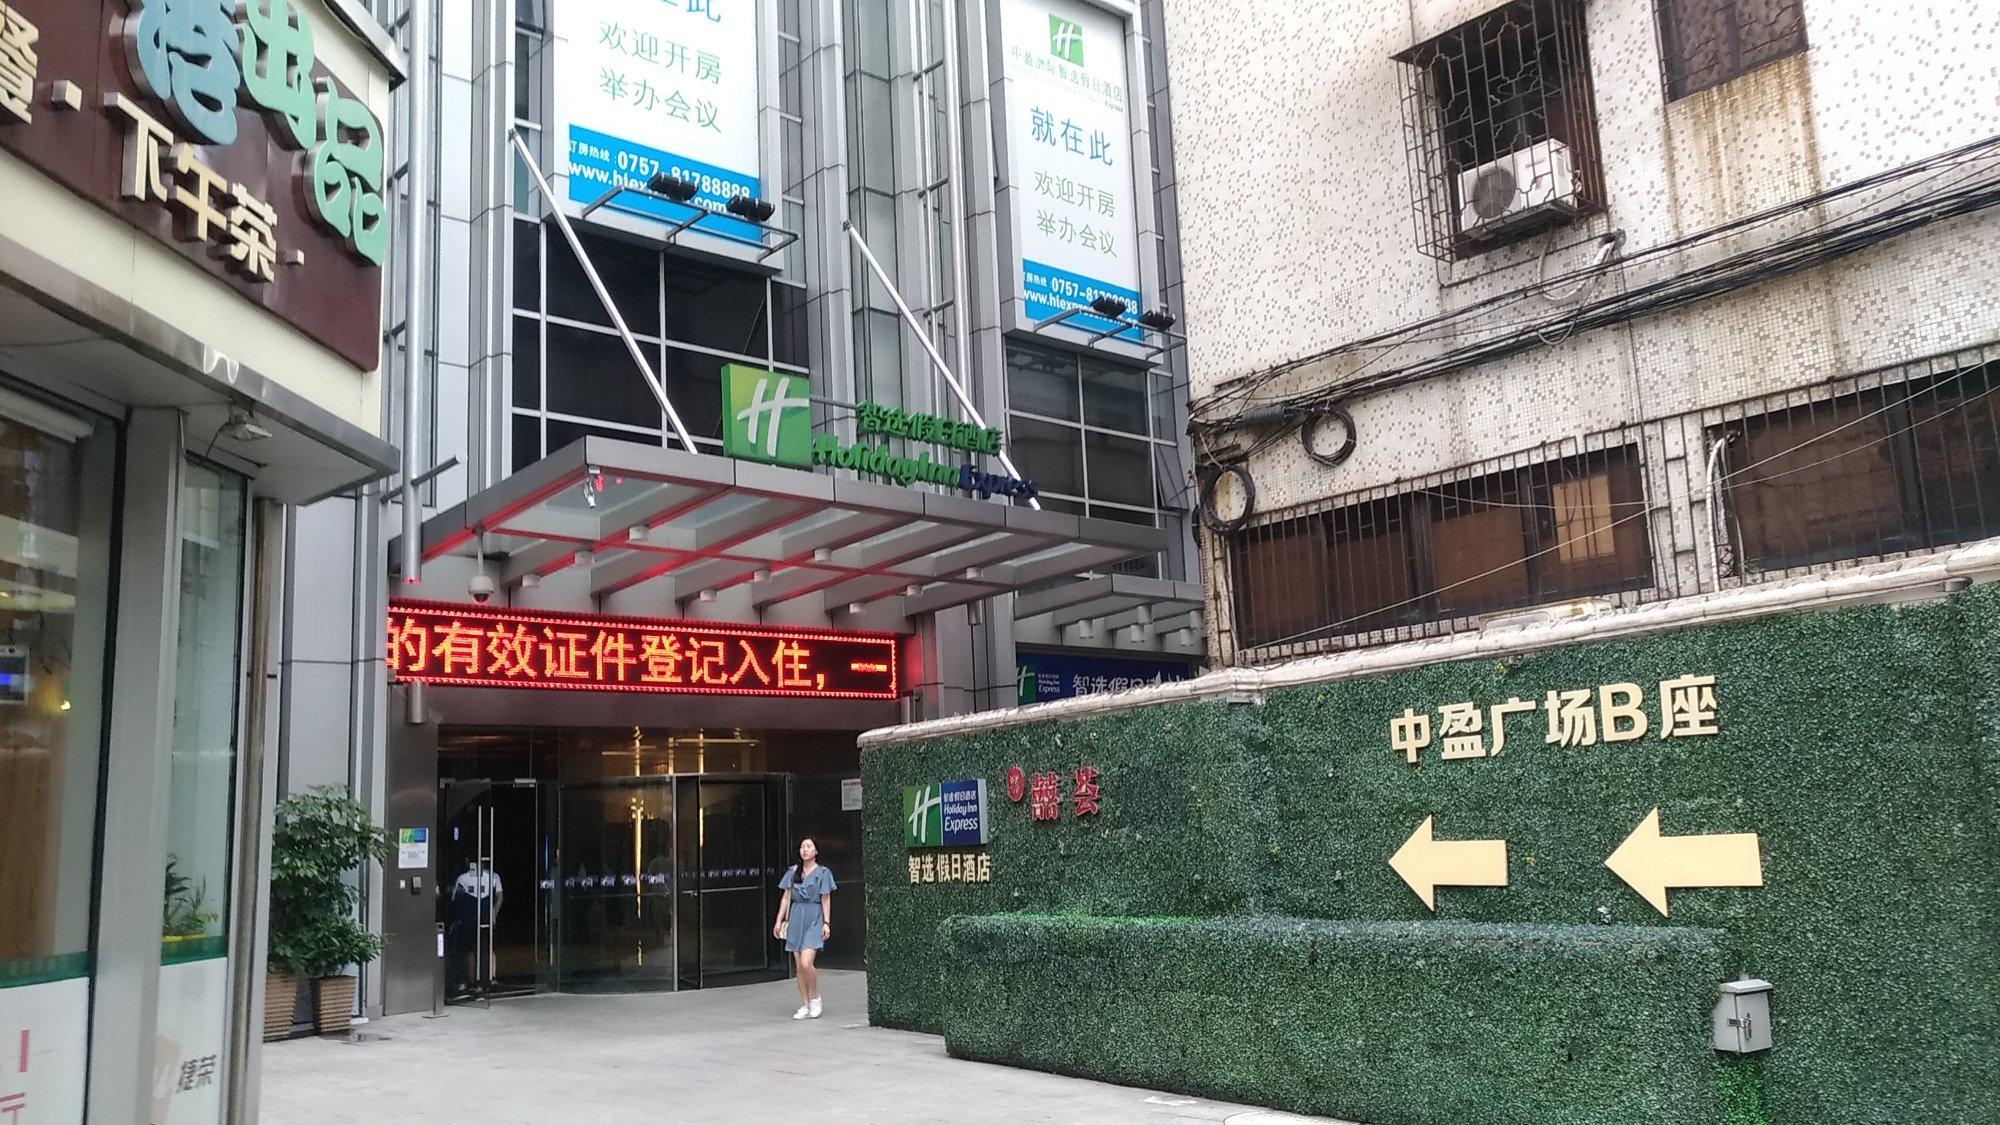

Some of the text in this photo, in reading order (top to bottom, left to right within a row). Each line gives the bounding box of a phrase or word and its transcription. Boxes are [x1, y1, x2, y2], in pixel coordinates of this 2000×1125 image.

[599, 20, 722, 86] 欢迎开房
[599, 66, 722, 134] 举办会议
[1030, 106, 1113, 167] 就在此
[1034, 170, 1116, 218] 欢迎开房
[1036, 208, 1118, 258] 举办会议
[1389, 673, 1719, 764] 中盈广场B座
[944, 816, 978, 834] Express
[908, 852, 991, 884] 智选假日酒店
